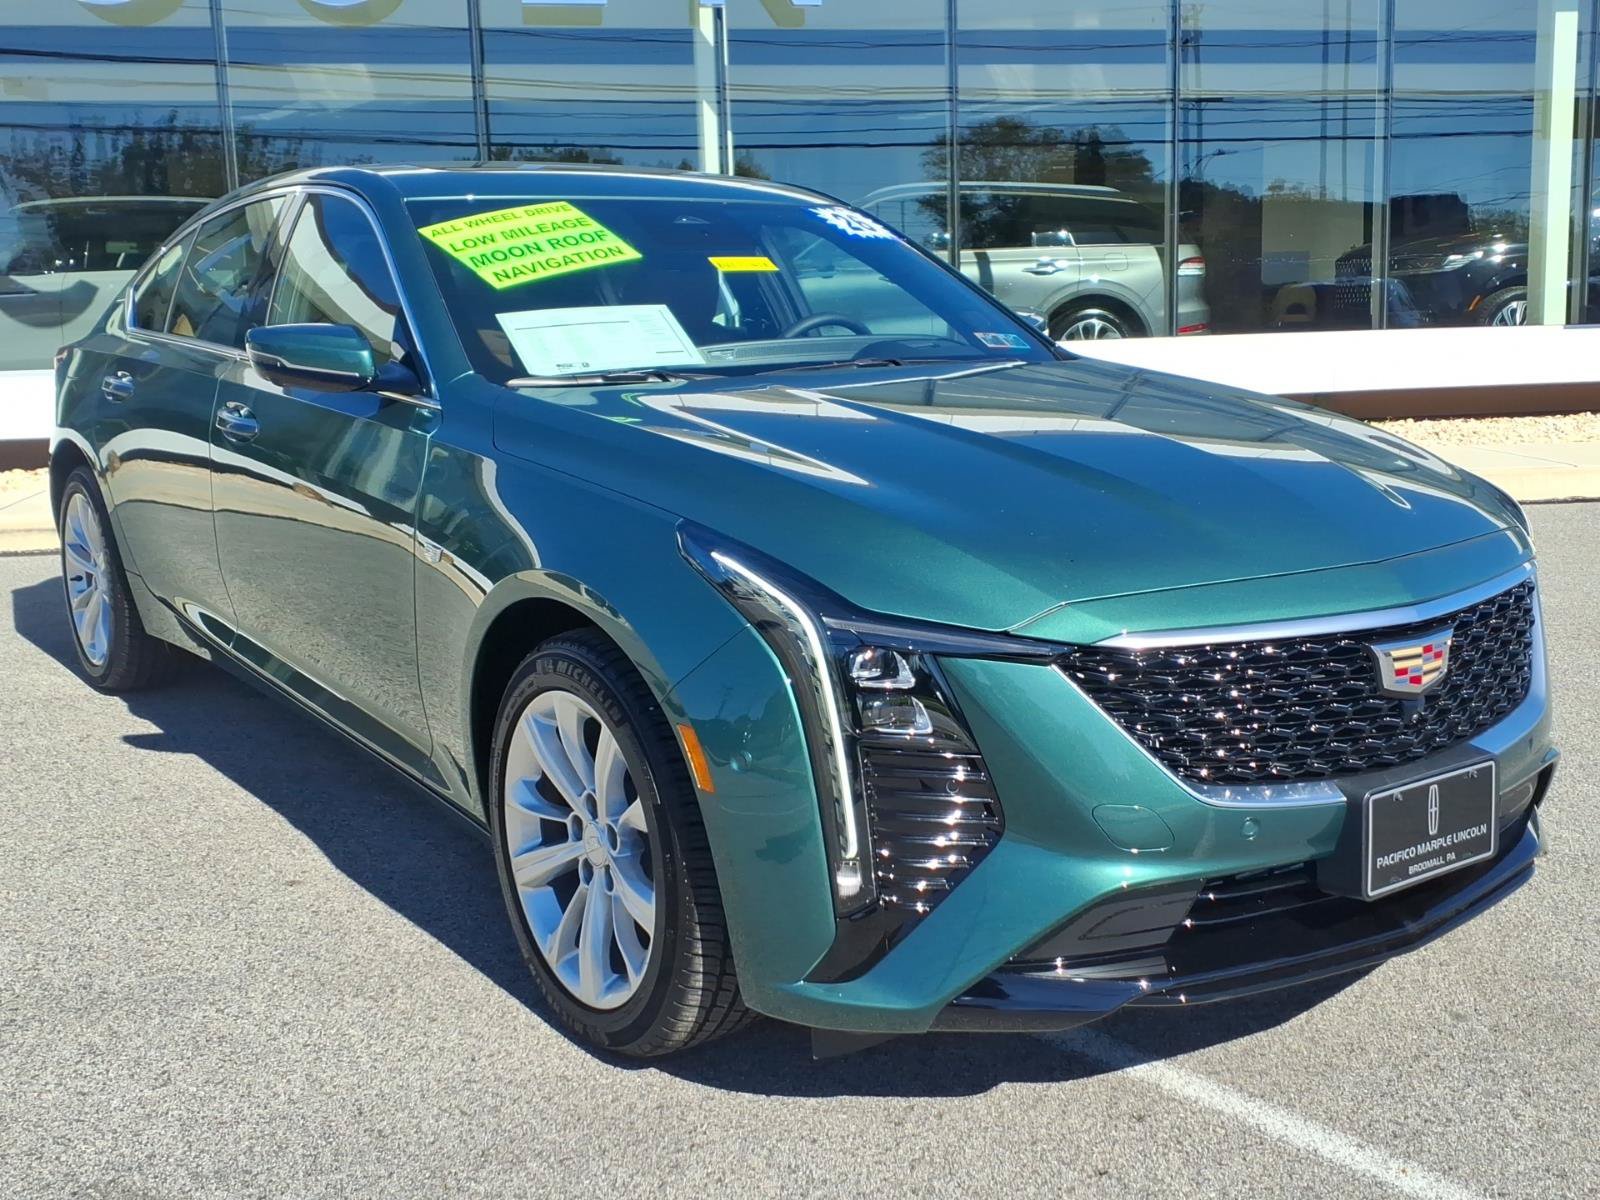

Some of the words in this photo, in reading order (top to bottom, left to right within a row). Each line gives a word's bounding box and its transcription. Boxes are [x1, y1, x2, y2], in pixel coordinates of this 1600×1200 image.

[430, 223, 463, 238] ALL
[464, 211, 522, 228] WHEEL
[524, 204, 573, 217] DRIVE
[449, 233, 497, 253] LOW
[500, 217, 593, 240] MILEAGE
[469, 241, 546, 268] MOON
[546, 229, 608, 250] ROOF
[492, 245, 625, 282] NAVIGATION
[556, 659, 624, 721] MICHELIN
[1376, 846, 1416, 869] PACIFICO
[1417, 834, 1452, 855] MARPLE
[1453, 823, 1487, 843] LINCOLN
[1446, 851, 1456, 863] PA
